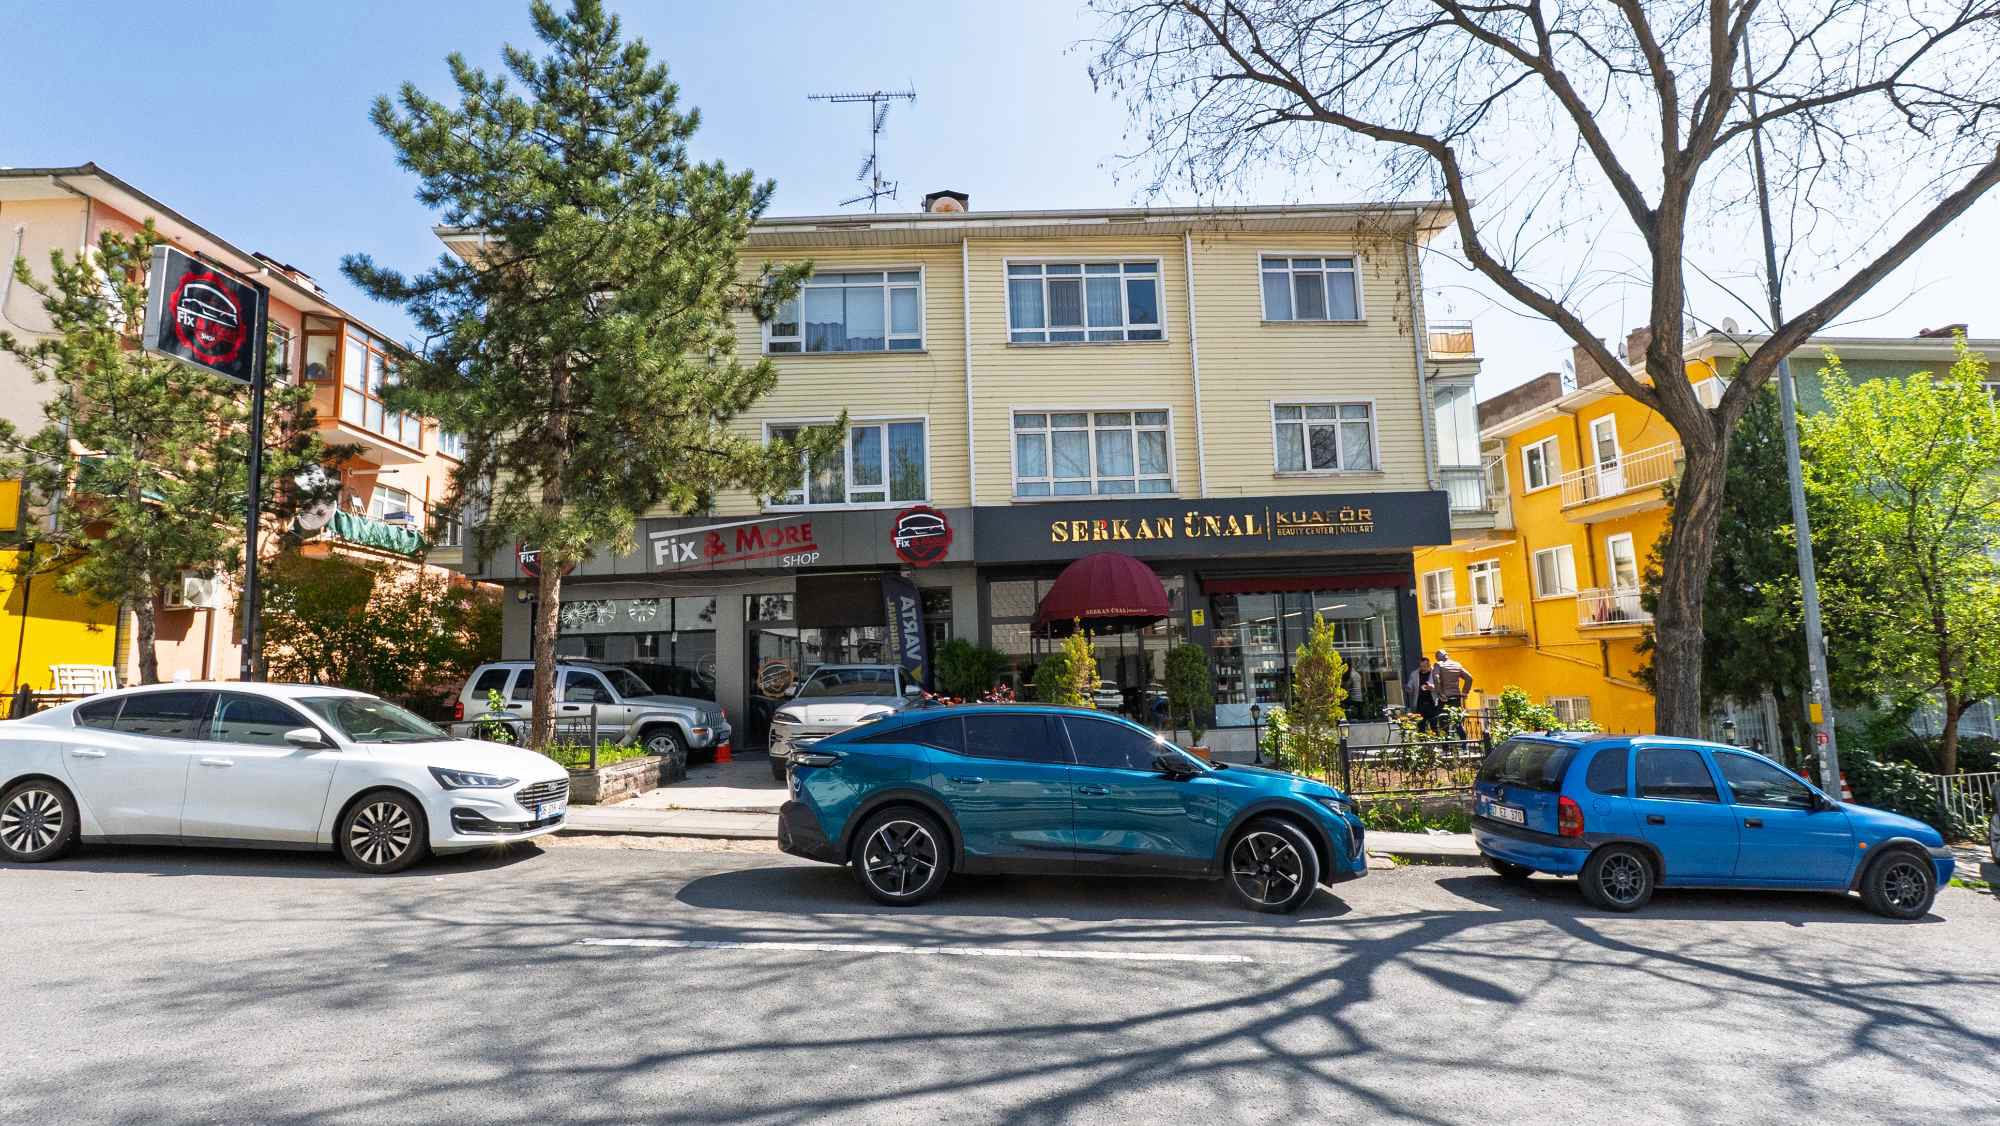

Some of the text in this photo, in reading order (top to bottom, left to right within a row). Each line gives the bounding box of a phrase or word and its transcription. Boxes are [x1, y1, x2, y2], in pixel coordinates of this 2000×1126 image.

[177, 309, 195, 328] Fix
[1276, 505, 1373, 524] KUAFÖR
[1051, 511, 1264, 543] SERKAN ÜNAL
[1277, 525, 1374, 536] BEAUTY CENTER NAIL ART
[653, 521, 814, 566] Fix & MORE
[895, 538, 911, 549] Fix
[520, 554, 535, 564] Fix
[783, 552, 820, 568] SHOP
